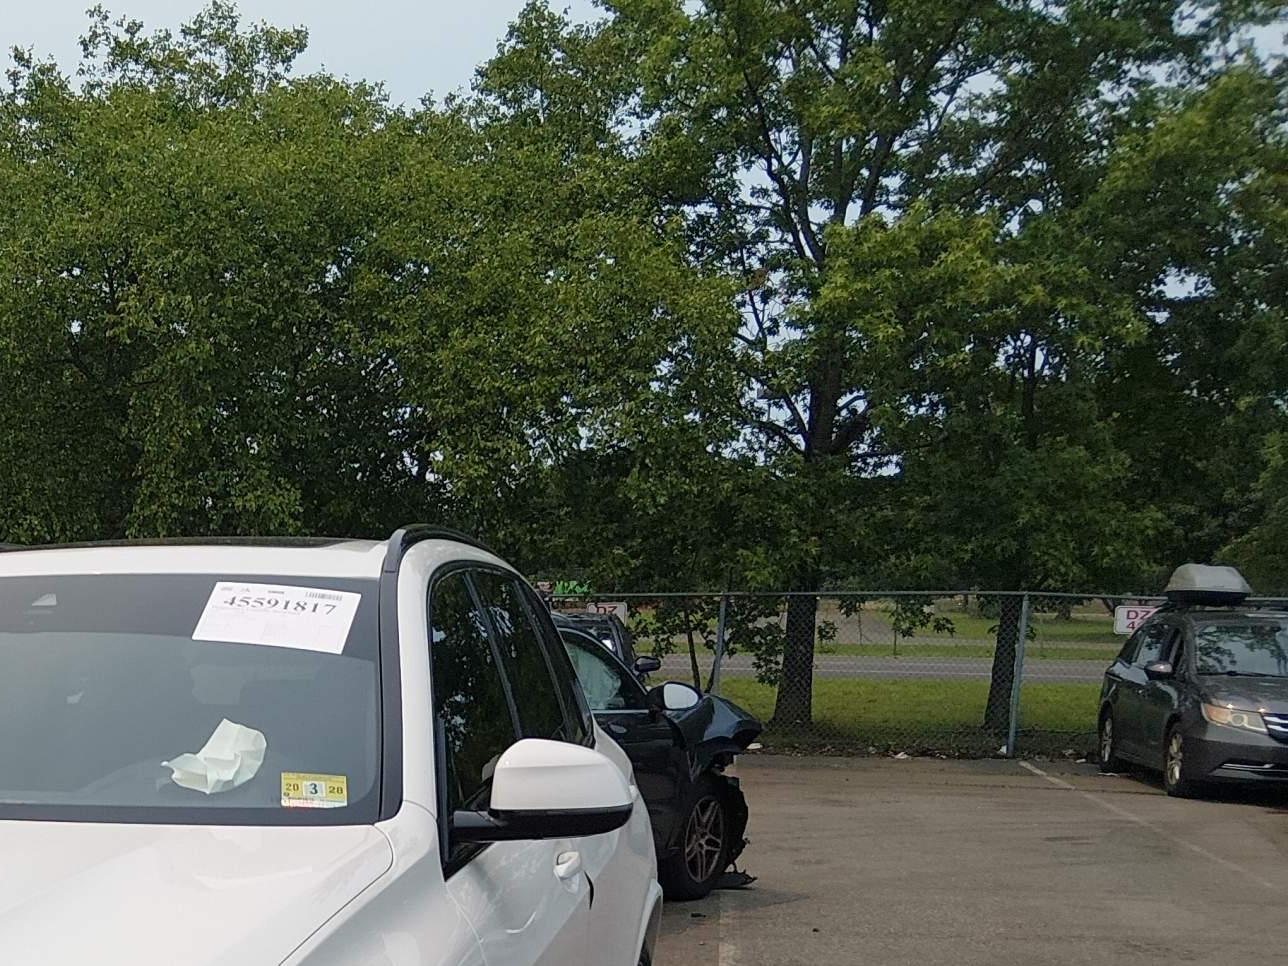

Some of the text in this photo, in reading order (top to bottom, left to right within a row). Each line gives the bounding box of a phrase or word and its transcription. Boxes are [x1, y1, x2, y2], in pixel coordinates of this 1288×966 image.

[223, 595, 337, 616] 45591817
[1126, 609, 1151, 620] DZ
[309, 782, 319, 795] 3
